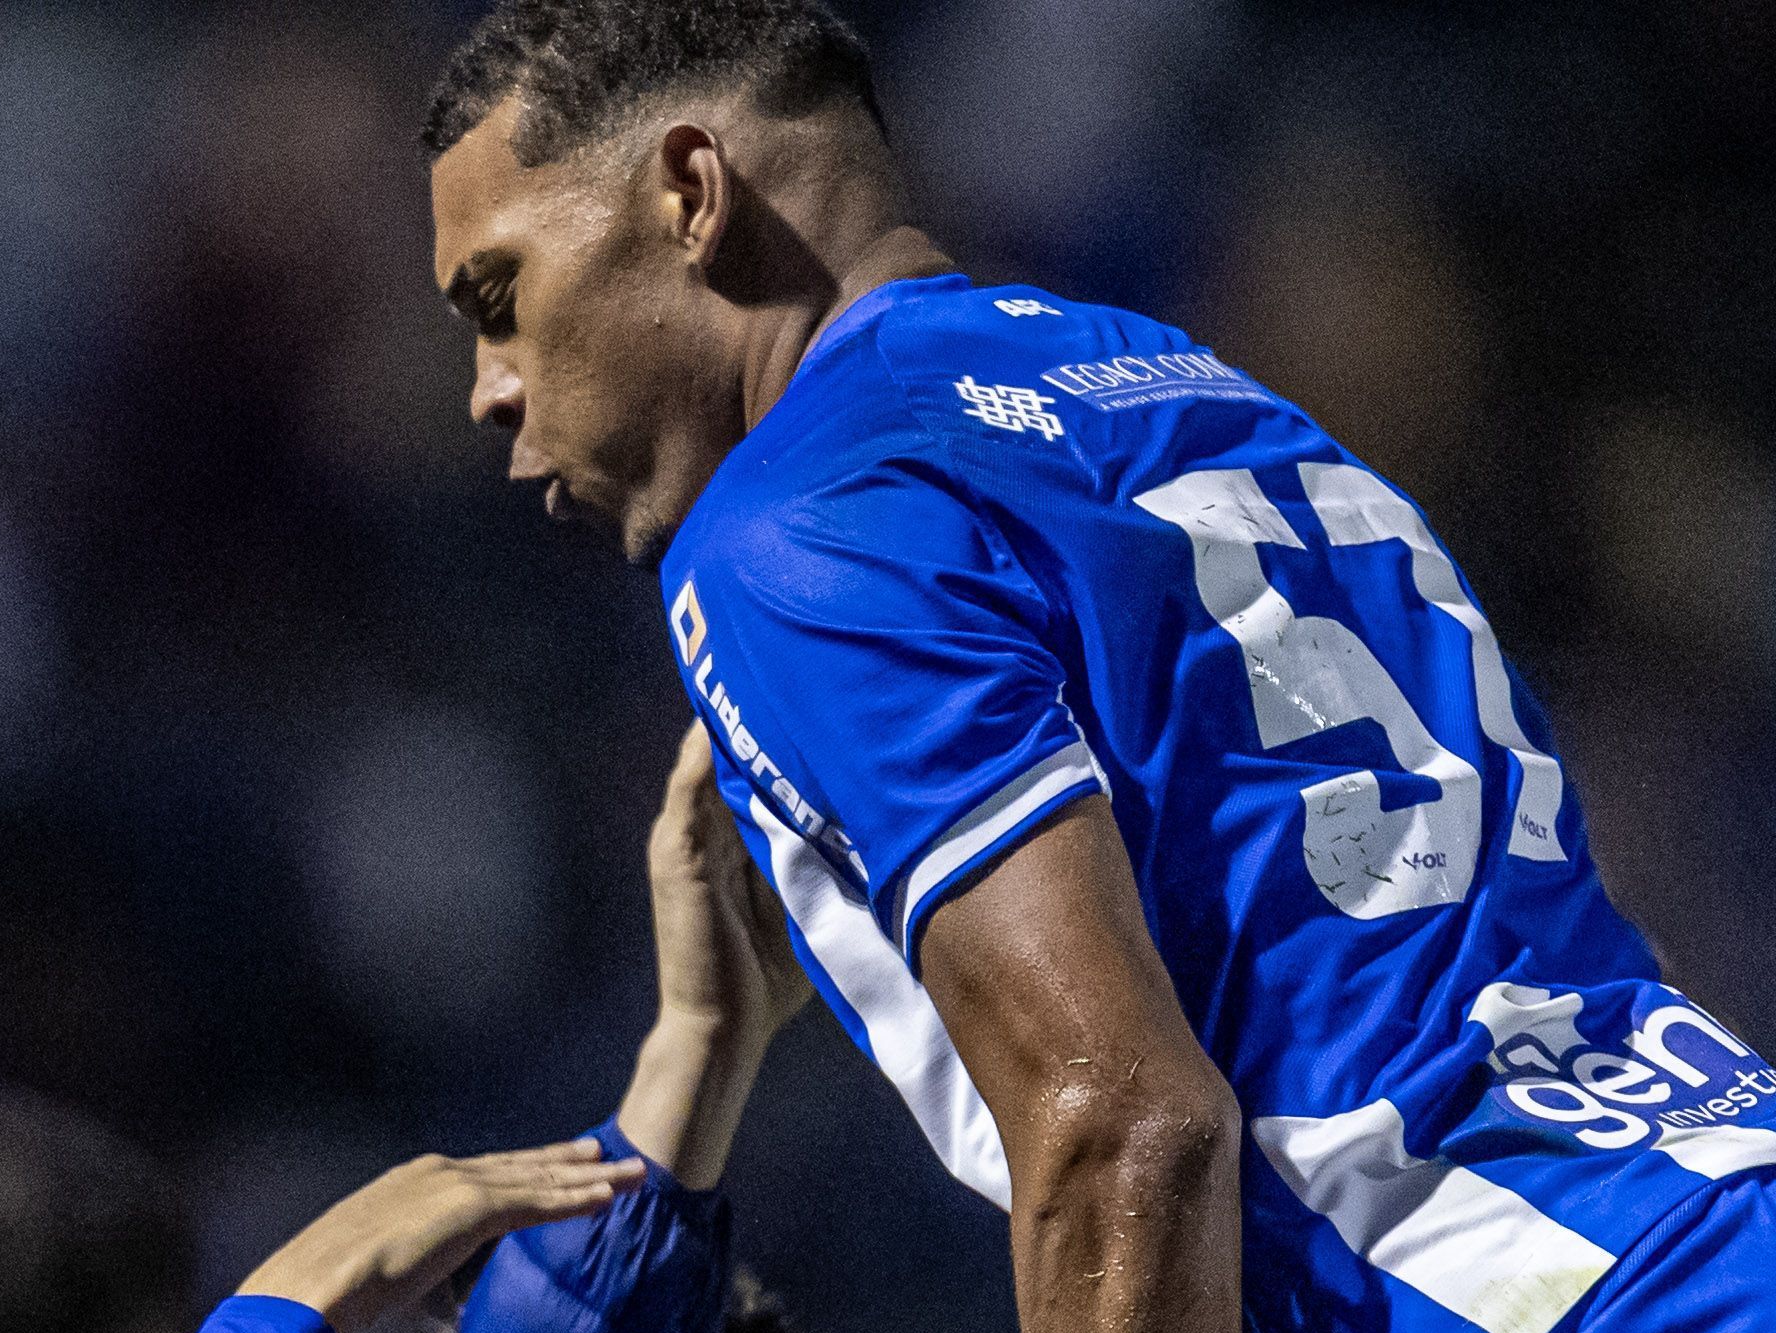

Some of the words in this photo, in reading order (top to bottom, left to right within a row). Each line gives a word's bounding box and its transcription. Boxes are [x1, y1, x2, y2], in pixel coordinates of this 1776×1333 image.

[1040, 355, 1166, 396] LEGACY
[1132, 462, 1569, 921] 57
[1505, 990, 1752, 1150] gen
